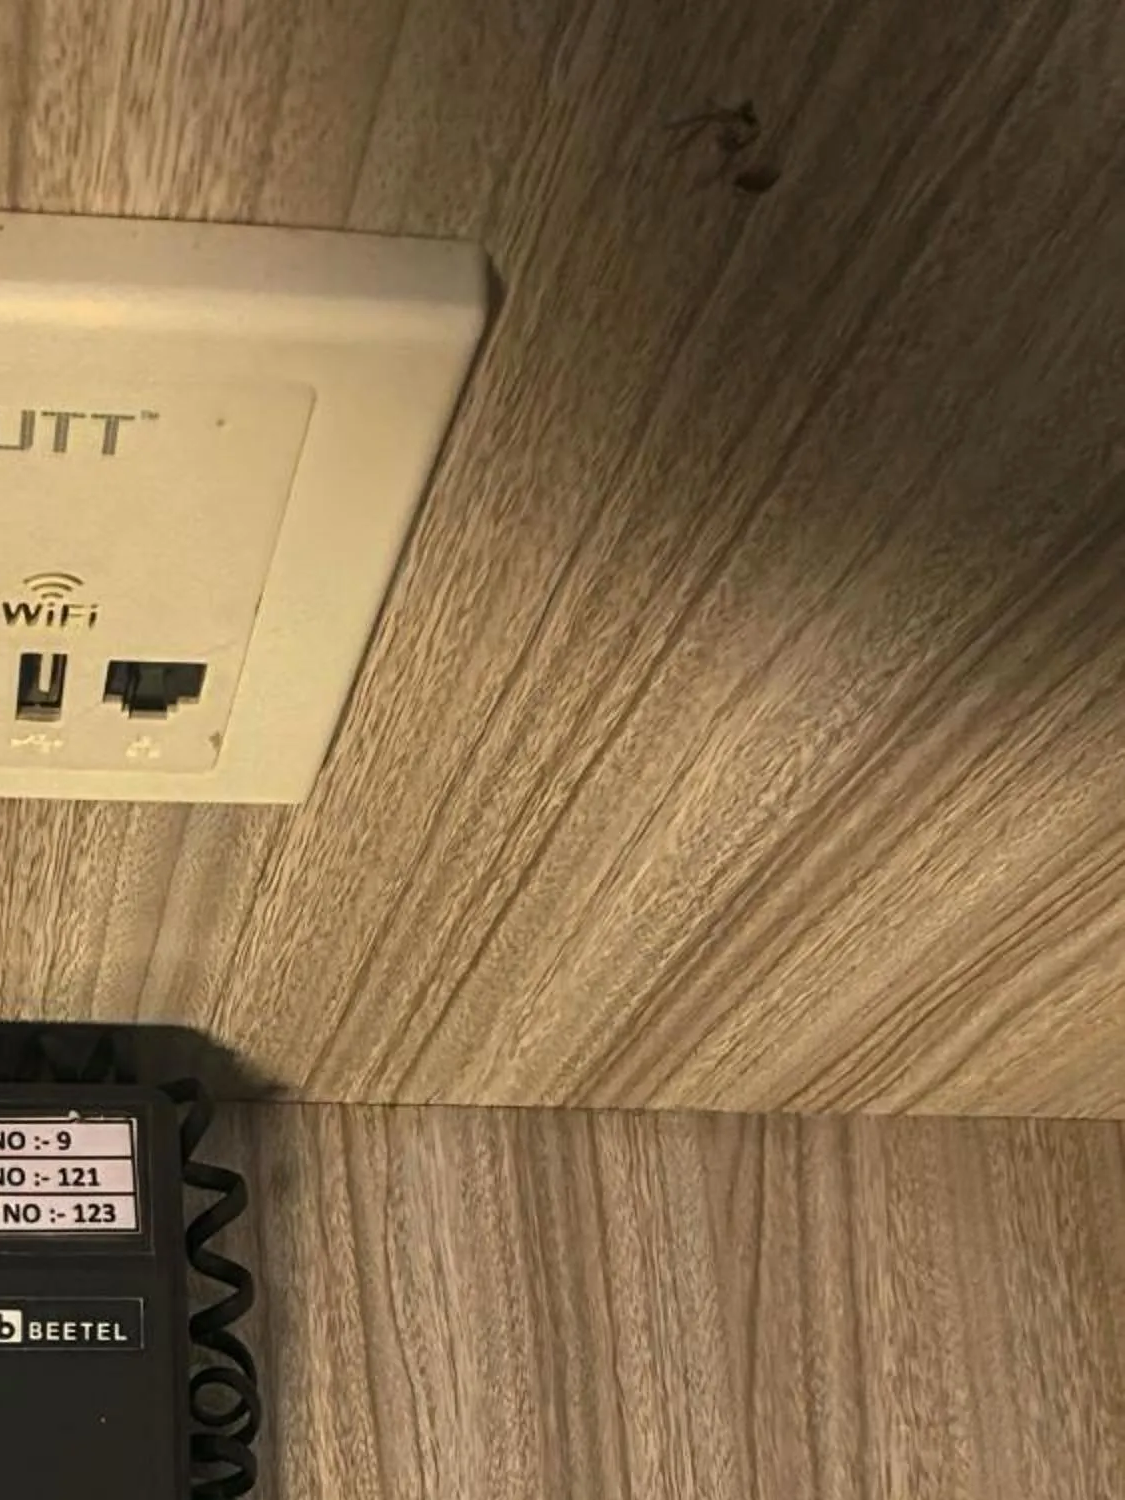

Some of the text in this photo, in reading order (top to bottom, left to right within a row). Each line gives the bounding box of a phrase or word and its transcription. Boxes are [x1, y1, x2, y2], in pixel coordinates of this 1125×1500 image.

[1, 601, 100, 630] WiFi
[56, 1130, 72, 1151] 9
[58, 1167, 100, 1187] 121
[2, 1203, 42, 1224] NO
[73, 1203, 117, 1224] 123
[28, 1321, 128, 1341] BEETEL
